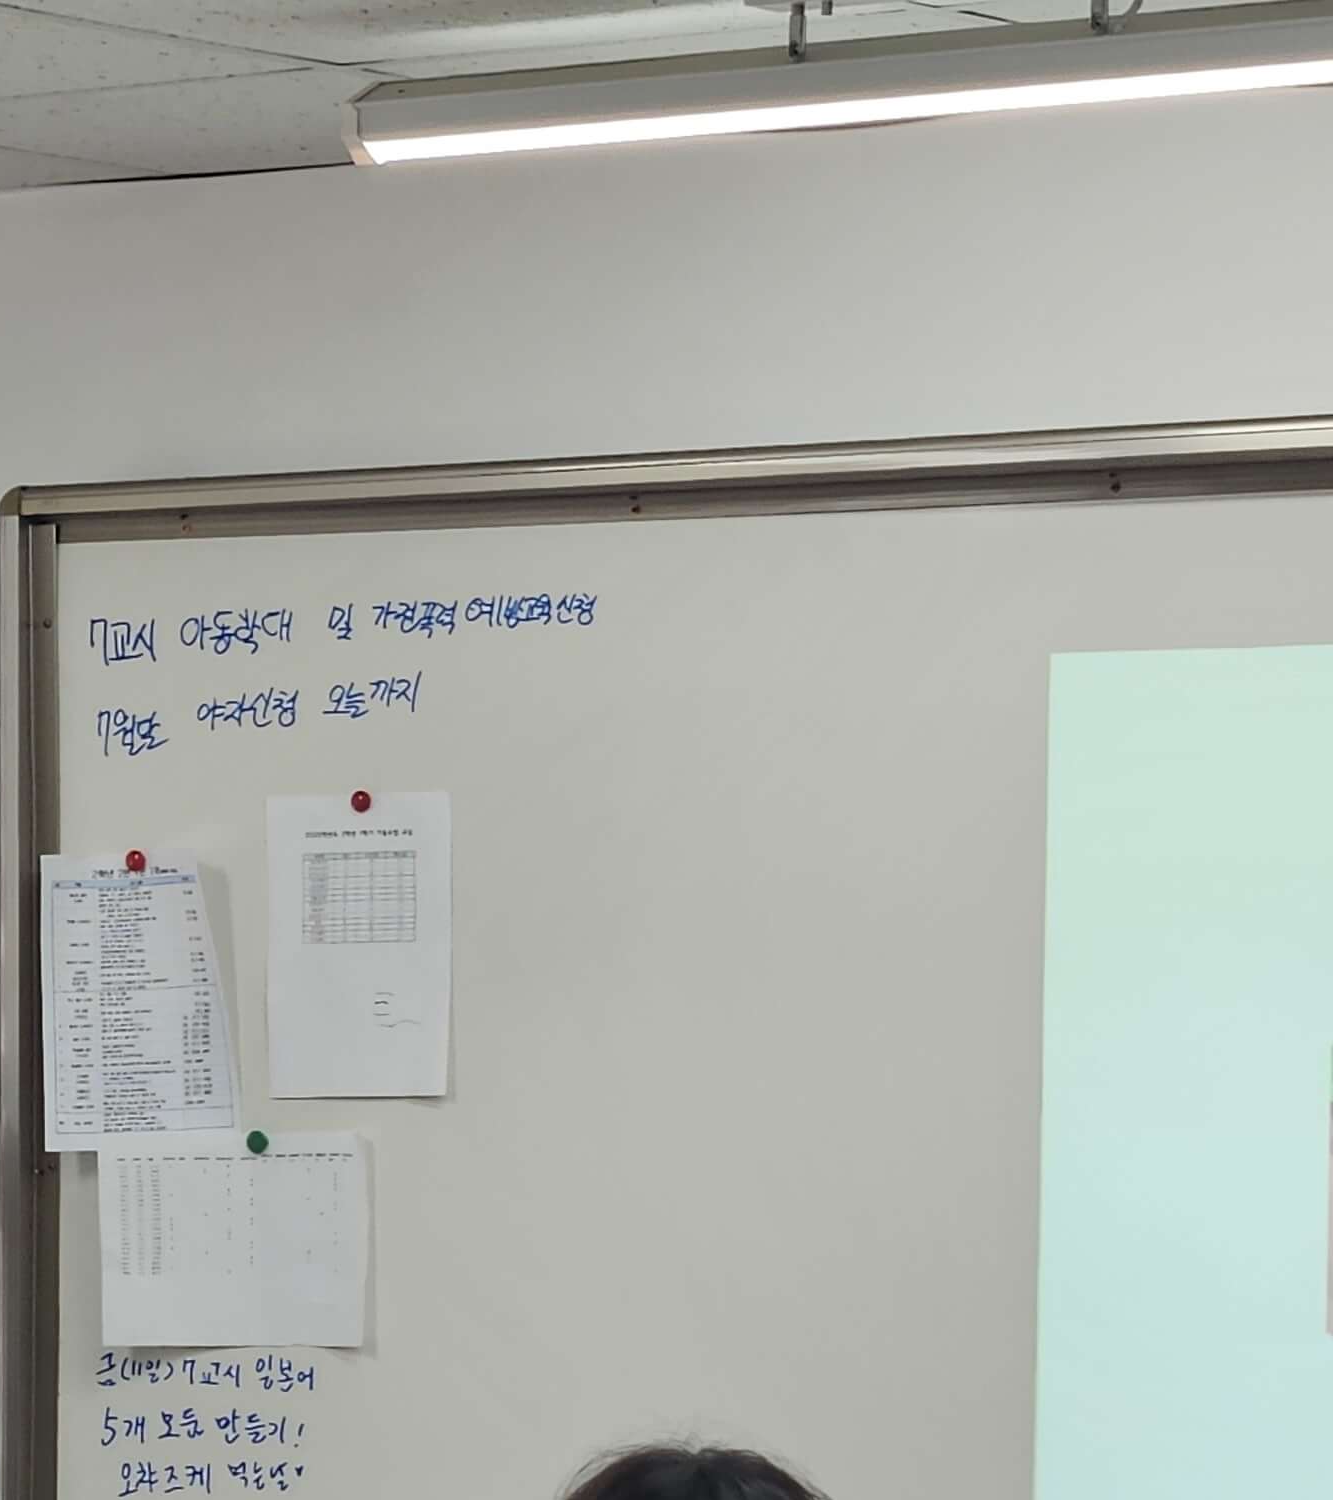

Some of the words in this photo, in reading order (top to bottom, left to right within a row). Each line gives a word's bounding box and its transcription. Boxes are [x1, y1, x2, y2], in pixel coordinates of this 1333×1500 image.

[90, 618, 157, 666] 7교시
[179, 608, 293, 655] 아동학대
[255, 1355, 316, 1392] 일본어
[100, 1406, 146, 1446] 5개
[158, 1407, 205, 1439] 모둠
